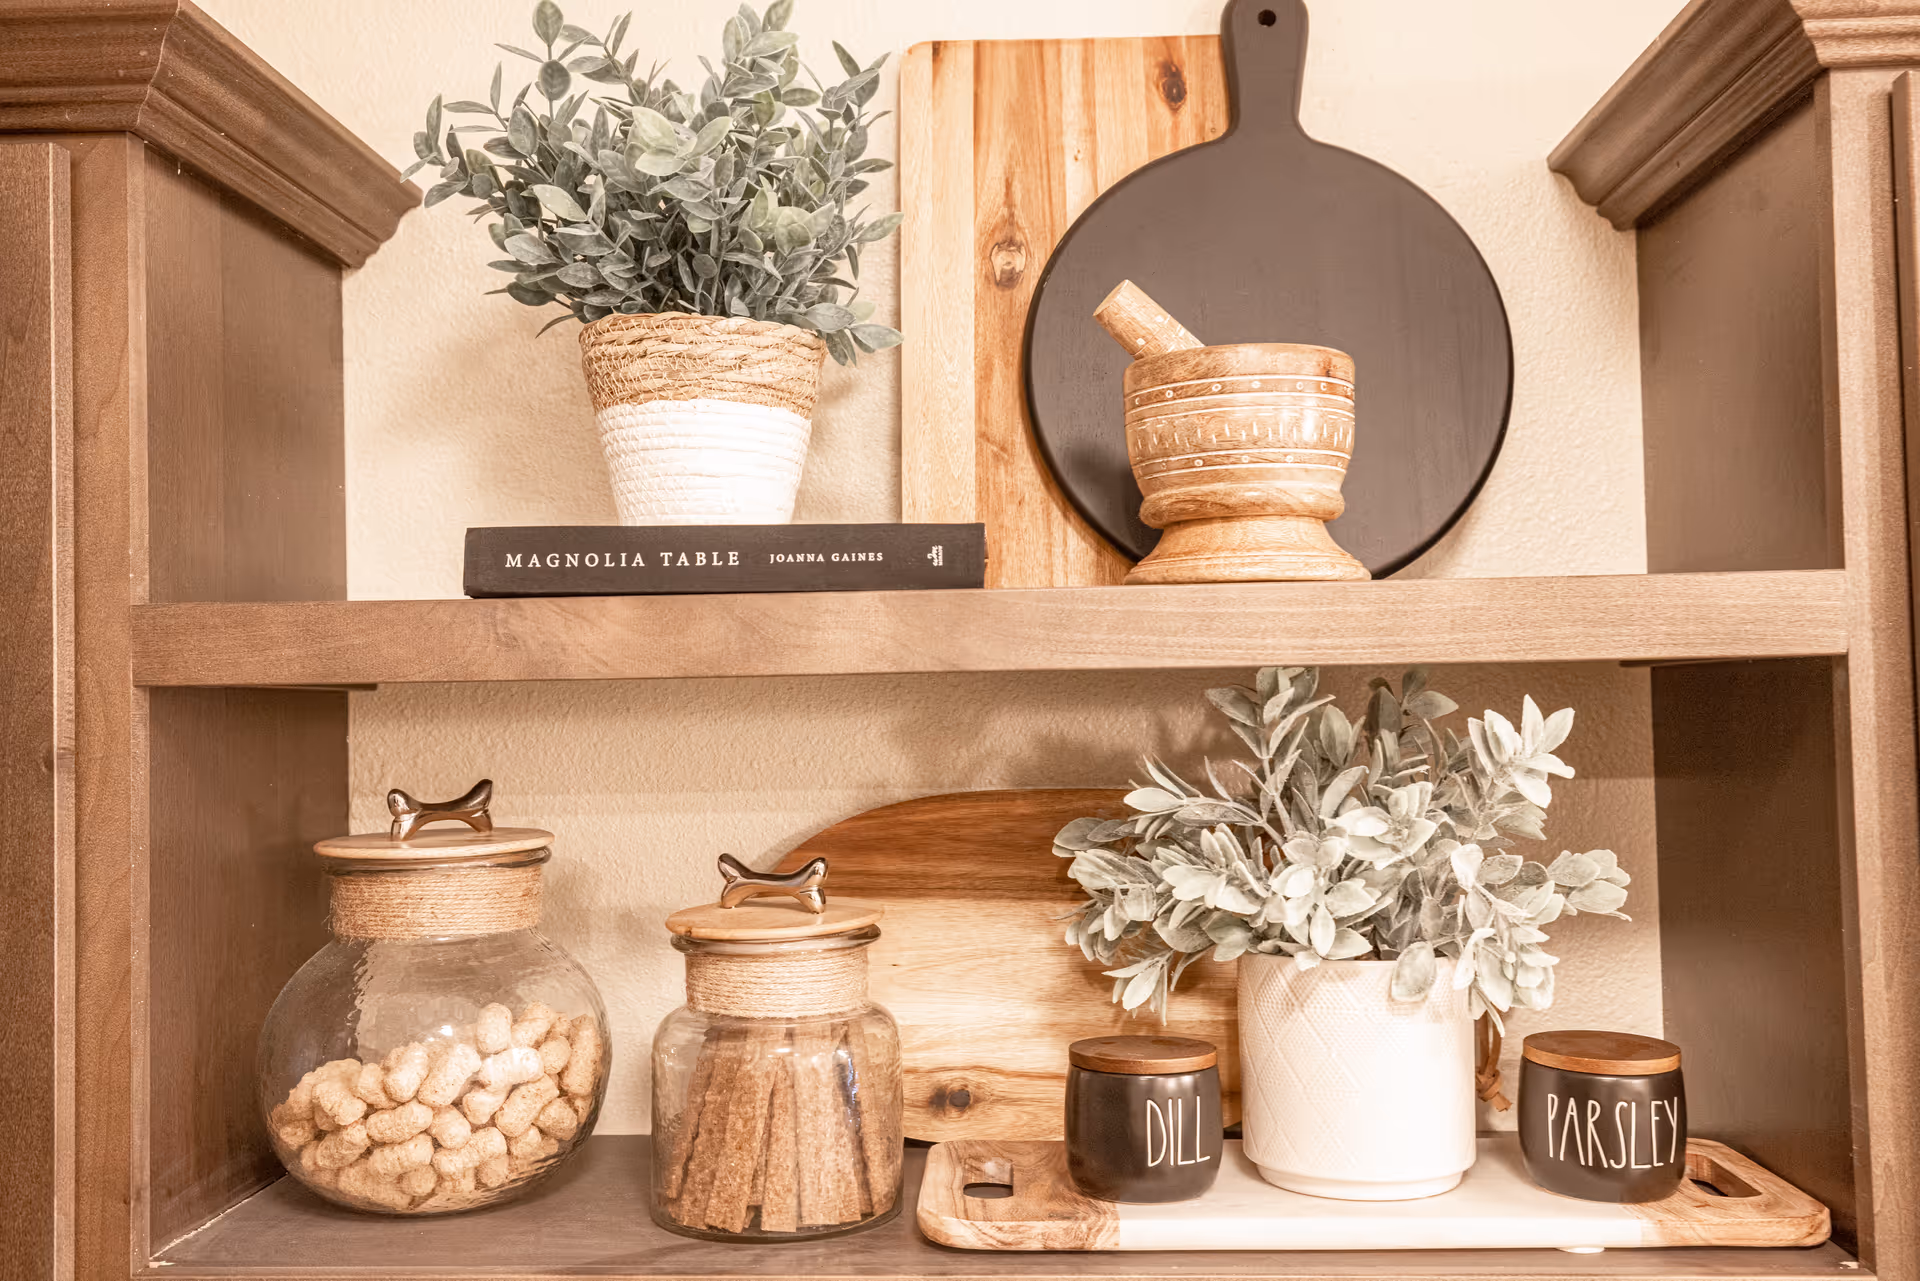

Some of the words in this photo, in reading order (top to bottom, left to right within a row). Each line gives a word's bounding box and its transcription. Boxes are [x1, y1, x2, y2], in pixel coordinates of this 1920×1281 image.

[504, 552, 647, 569] MAGNOLIA
[659, 551, 741, 567] TABLE
[769, 552, 825, 564] JOANNA
[830, 552, 884, 562] GAINES
[1146, 1095, 1211, 1167] DILL
[1547, 1093, 1678, 1169] PARSLEY
